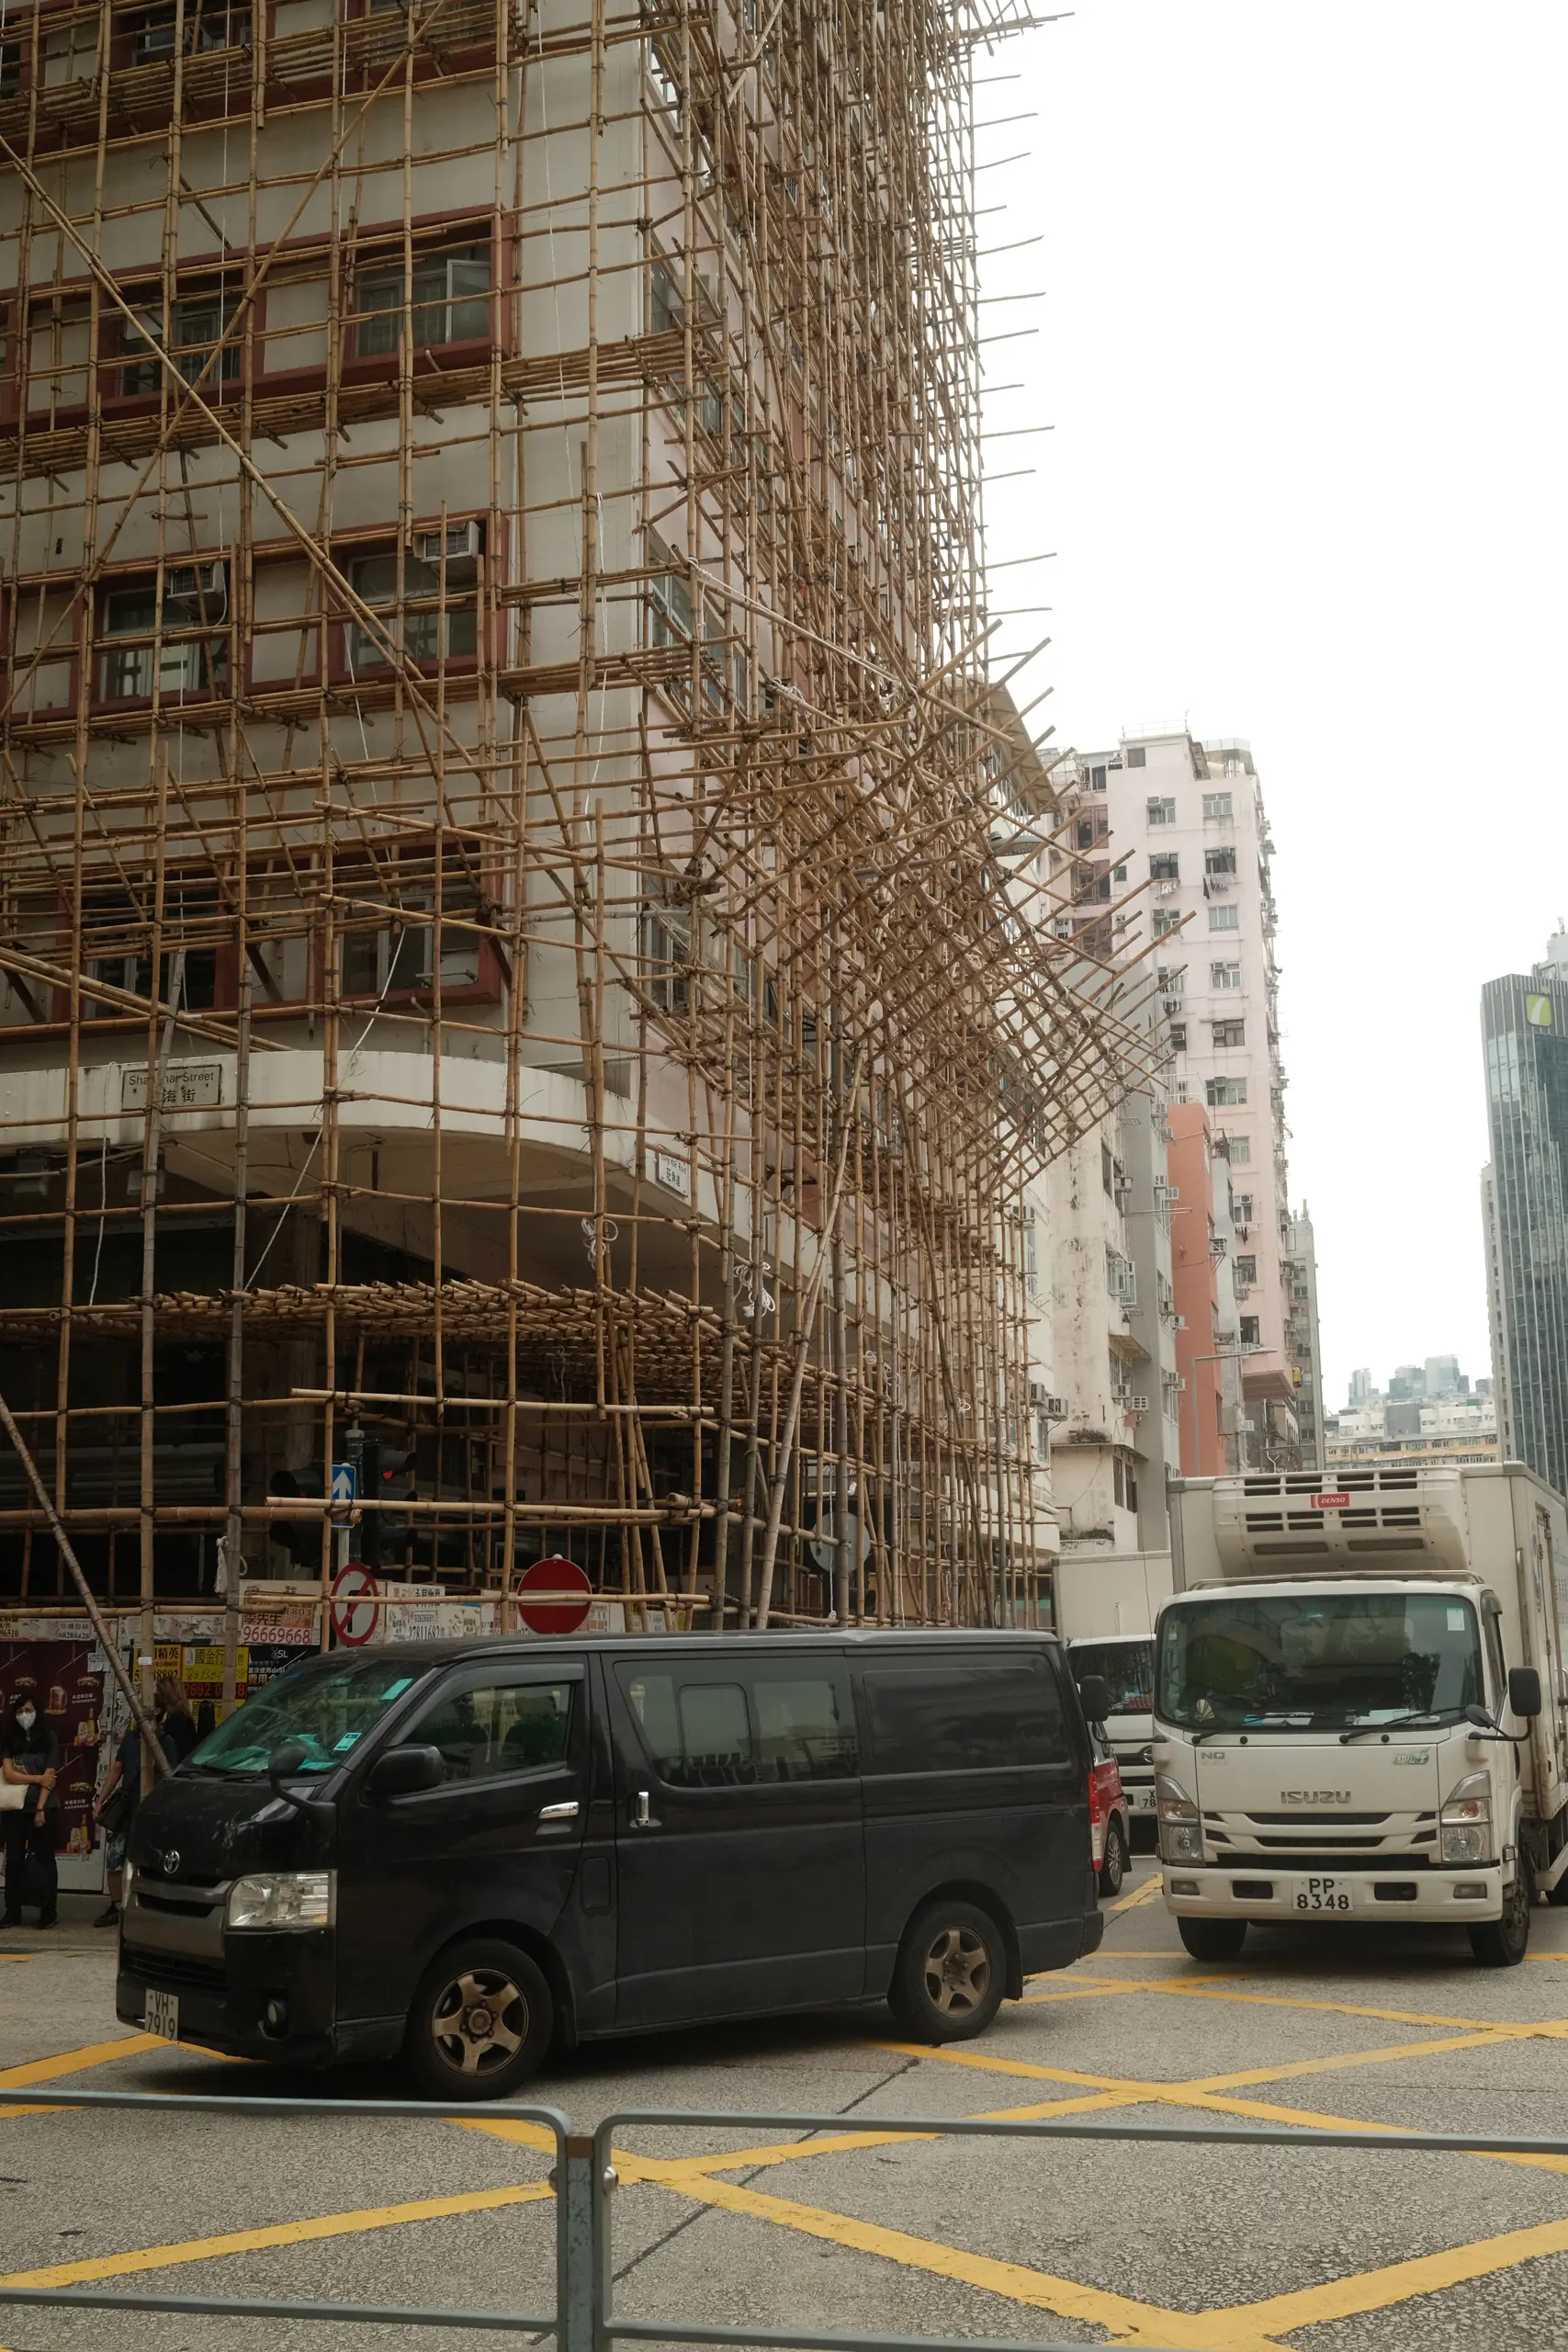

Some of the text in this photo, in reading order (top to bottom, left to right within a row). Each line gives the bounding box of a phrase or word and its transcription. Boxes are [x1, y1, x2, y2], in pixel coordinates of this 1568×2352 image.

[130, 1071, 214, 1086] Shahai Street
[161, 1088, 196, 1103] 海街
[243, 1626, 311, 1644] 96669668
[1142, 1798, 1156, 1808] 78
[1280, 1791, 1351, 1804] ISUZU
[1309, 1878, 1335, 1894] PP
[1296, 1894, 1350, 1910] 8348
[155, 1992, 169, 2016] VH
[148, 2011, 176, 2040] 7919
